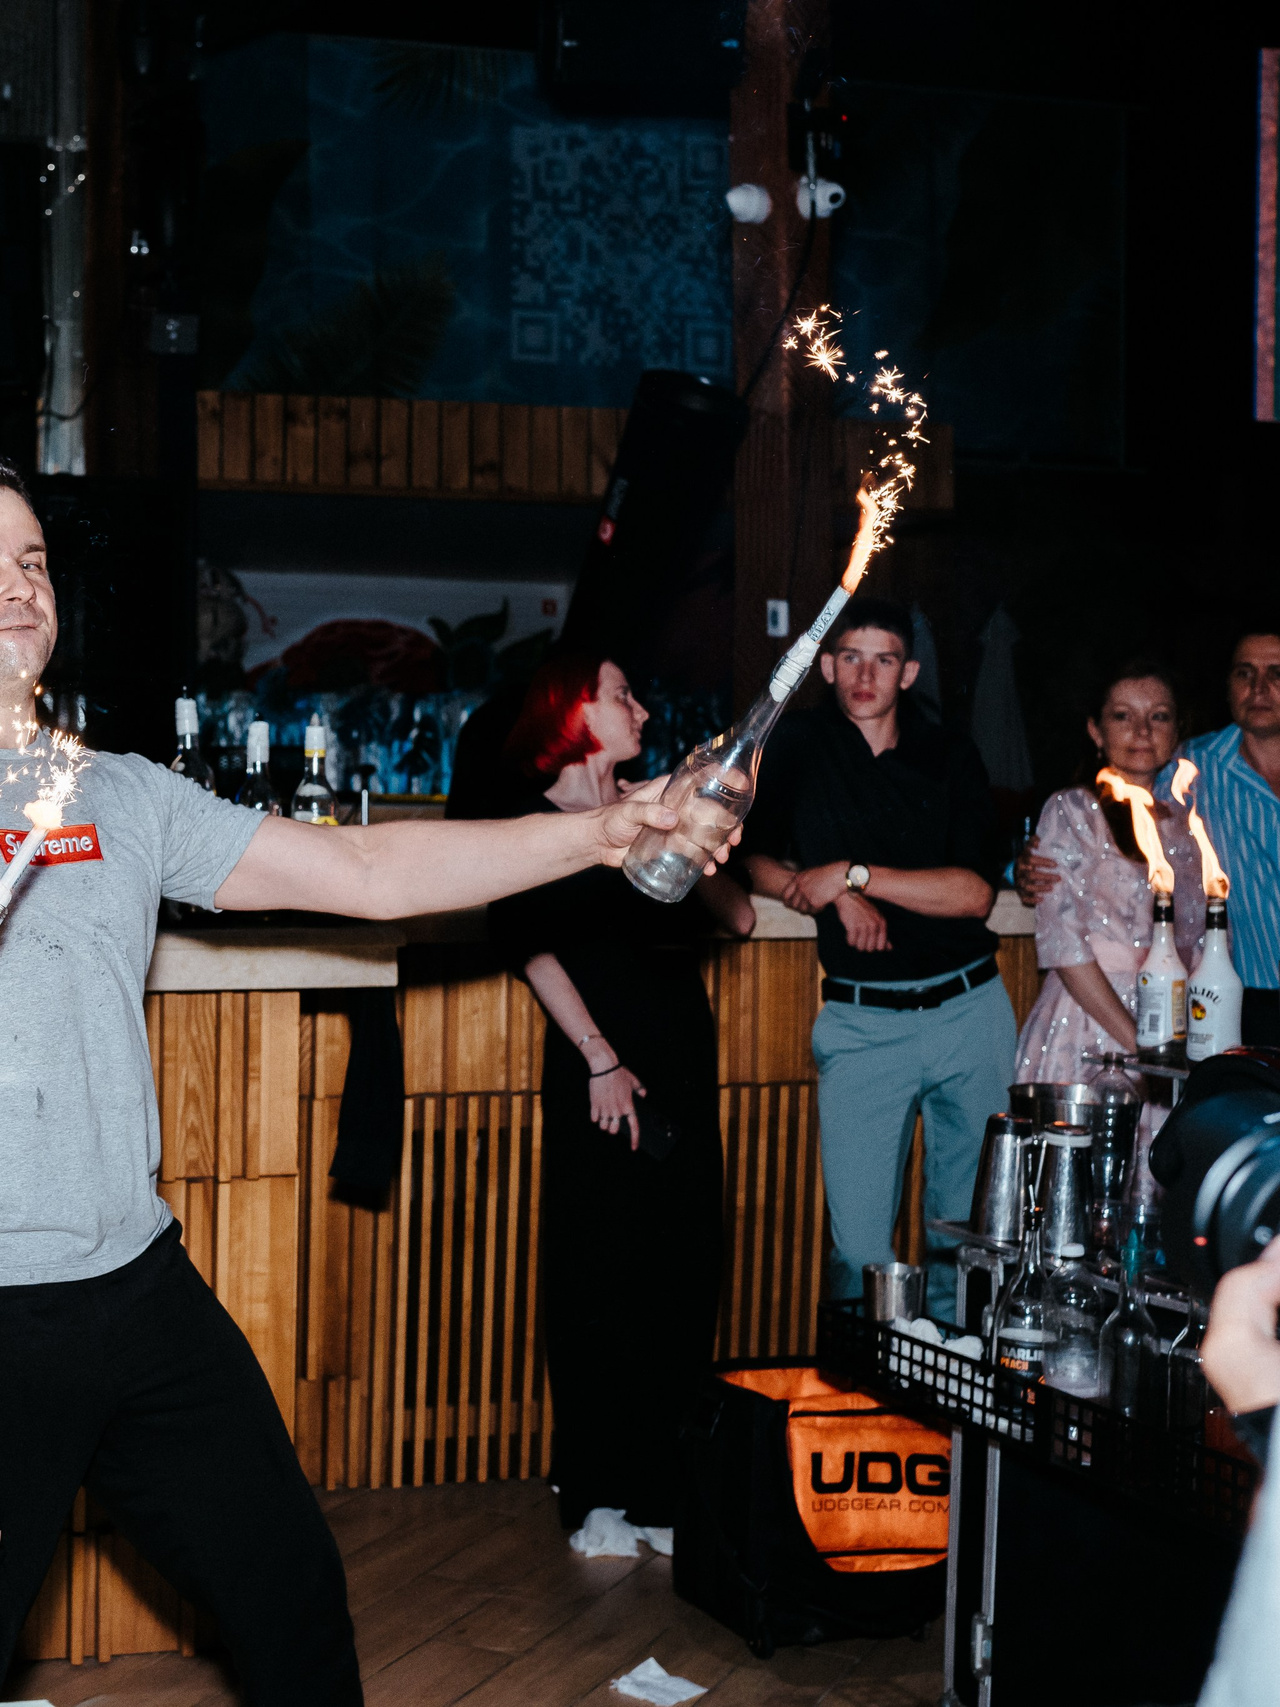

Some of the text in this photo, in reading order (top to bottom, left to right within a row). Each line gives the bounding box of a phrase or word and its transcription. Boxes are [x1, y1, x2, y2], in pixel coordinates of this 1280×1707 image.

[5, 834, 94, 863] Sreme
[1188, 986, 1222, 1005] ALIBU
[811, 1452, 950, 1496] UDG
